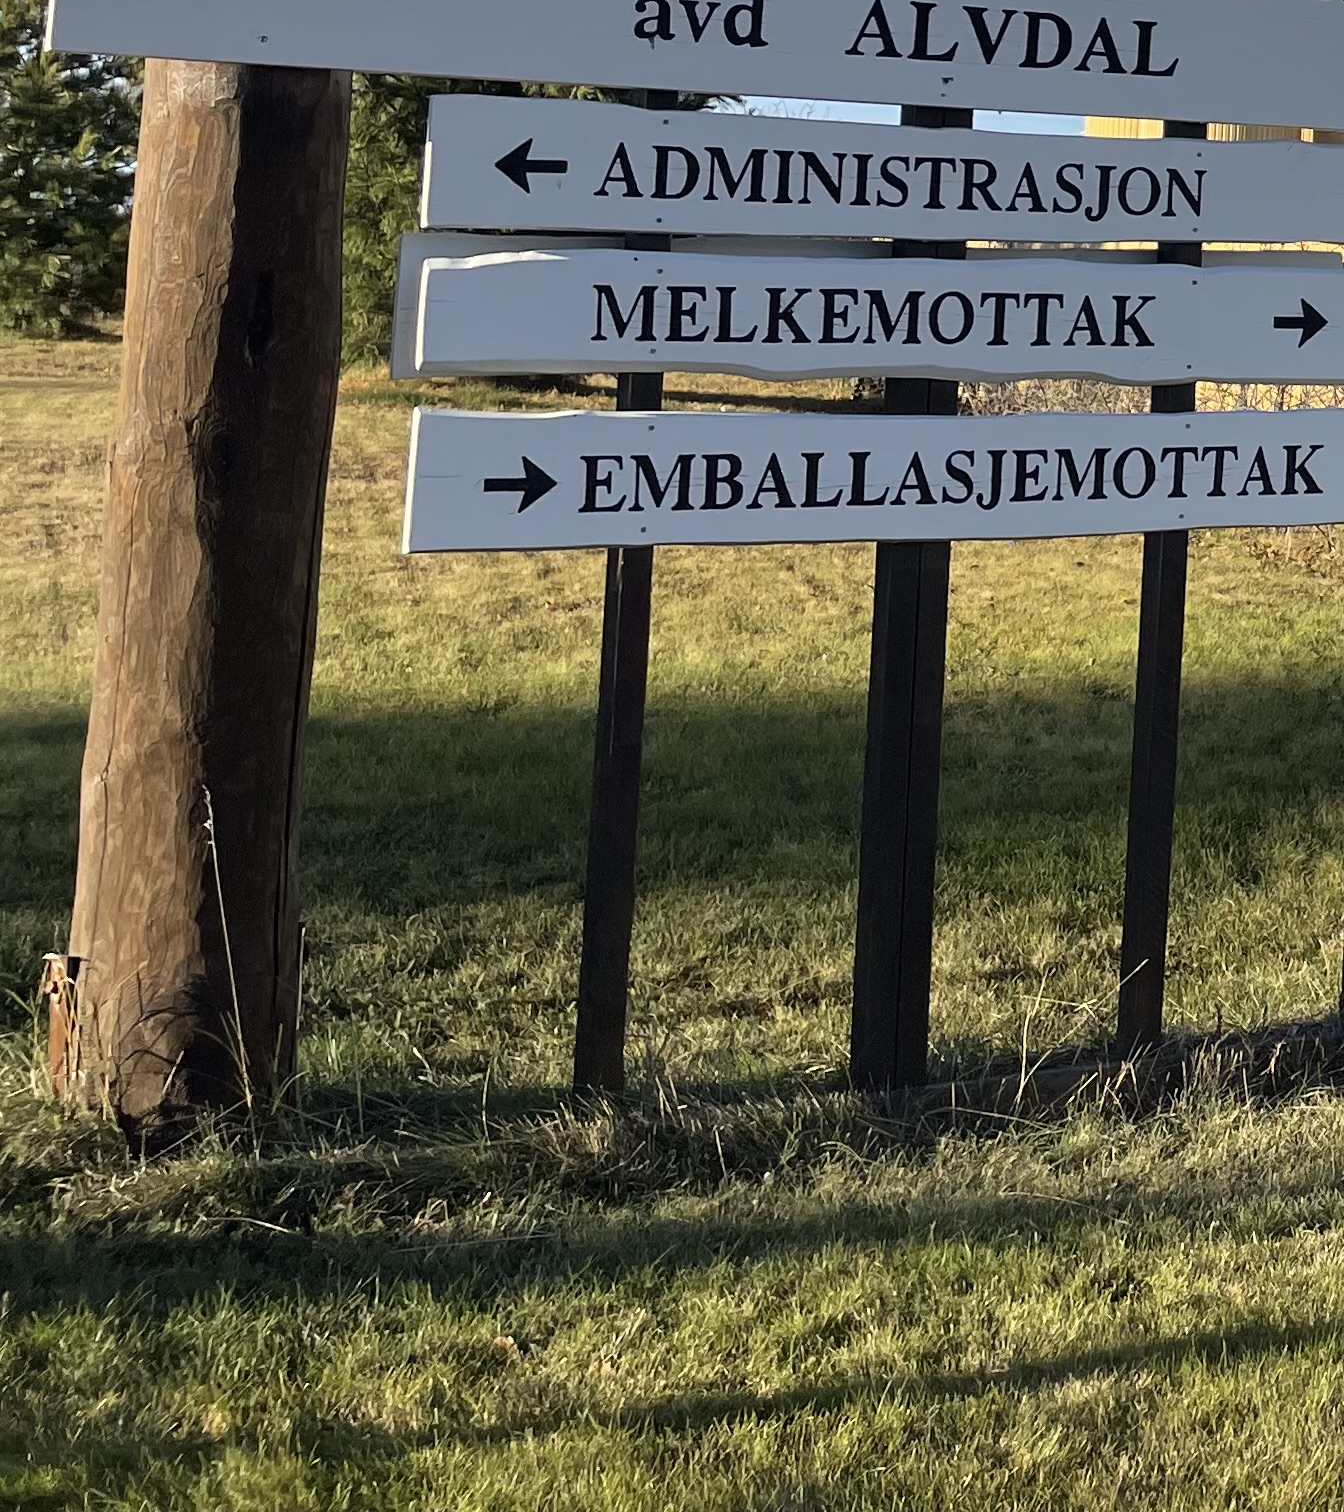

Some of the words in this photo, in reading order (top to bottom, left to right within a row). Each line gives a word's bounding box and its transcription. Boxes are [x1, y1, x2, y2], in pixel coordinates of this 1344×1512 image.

[593, 141, 1208, 222] ADMINISTRASJON
[590, 284, 1157, 347] MELKEMOTTAK
[577, 444, 1325, 514] EMBALLASJEMOTTAK
